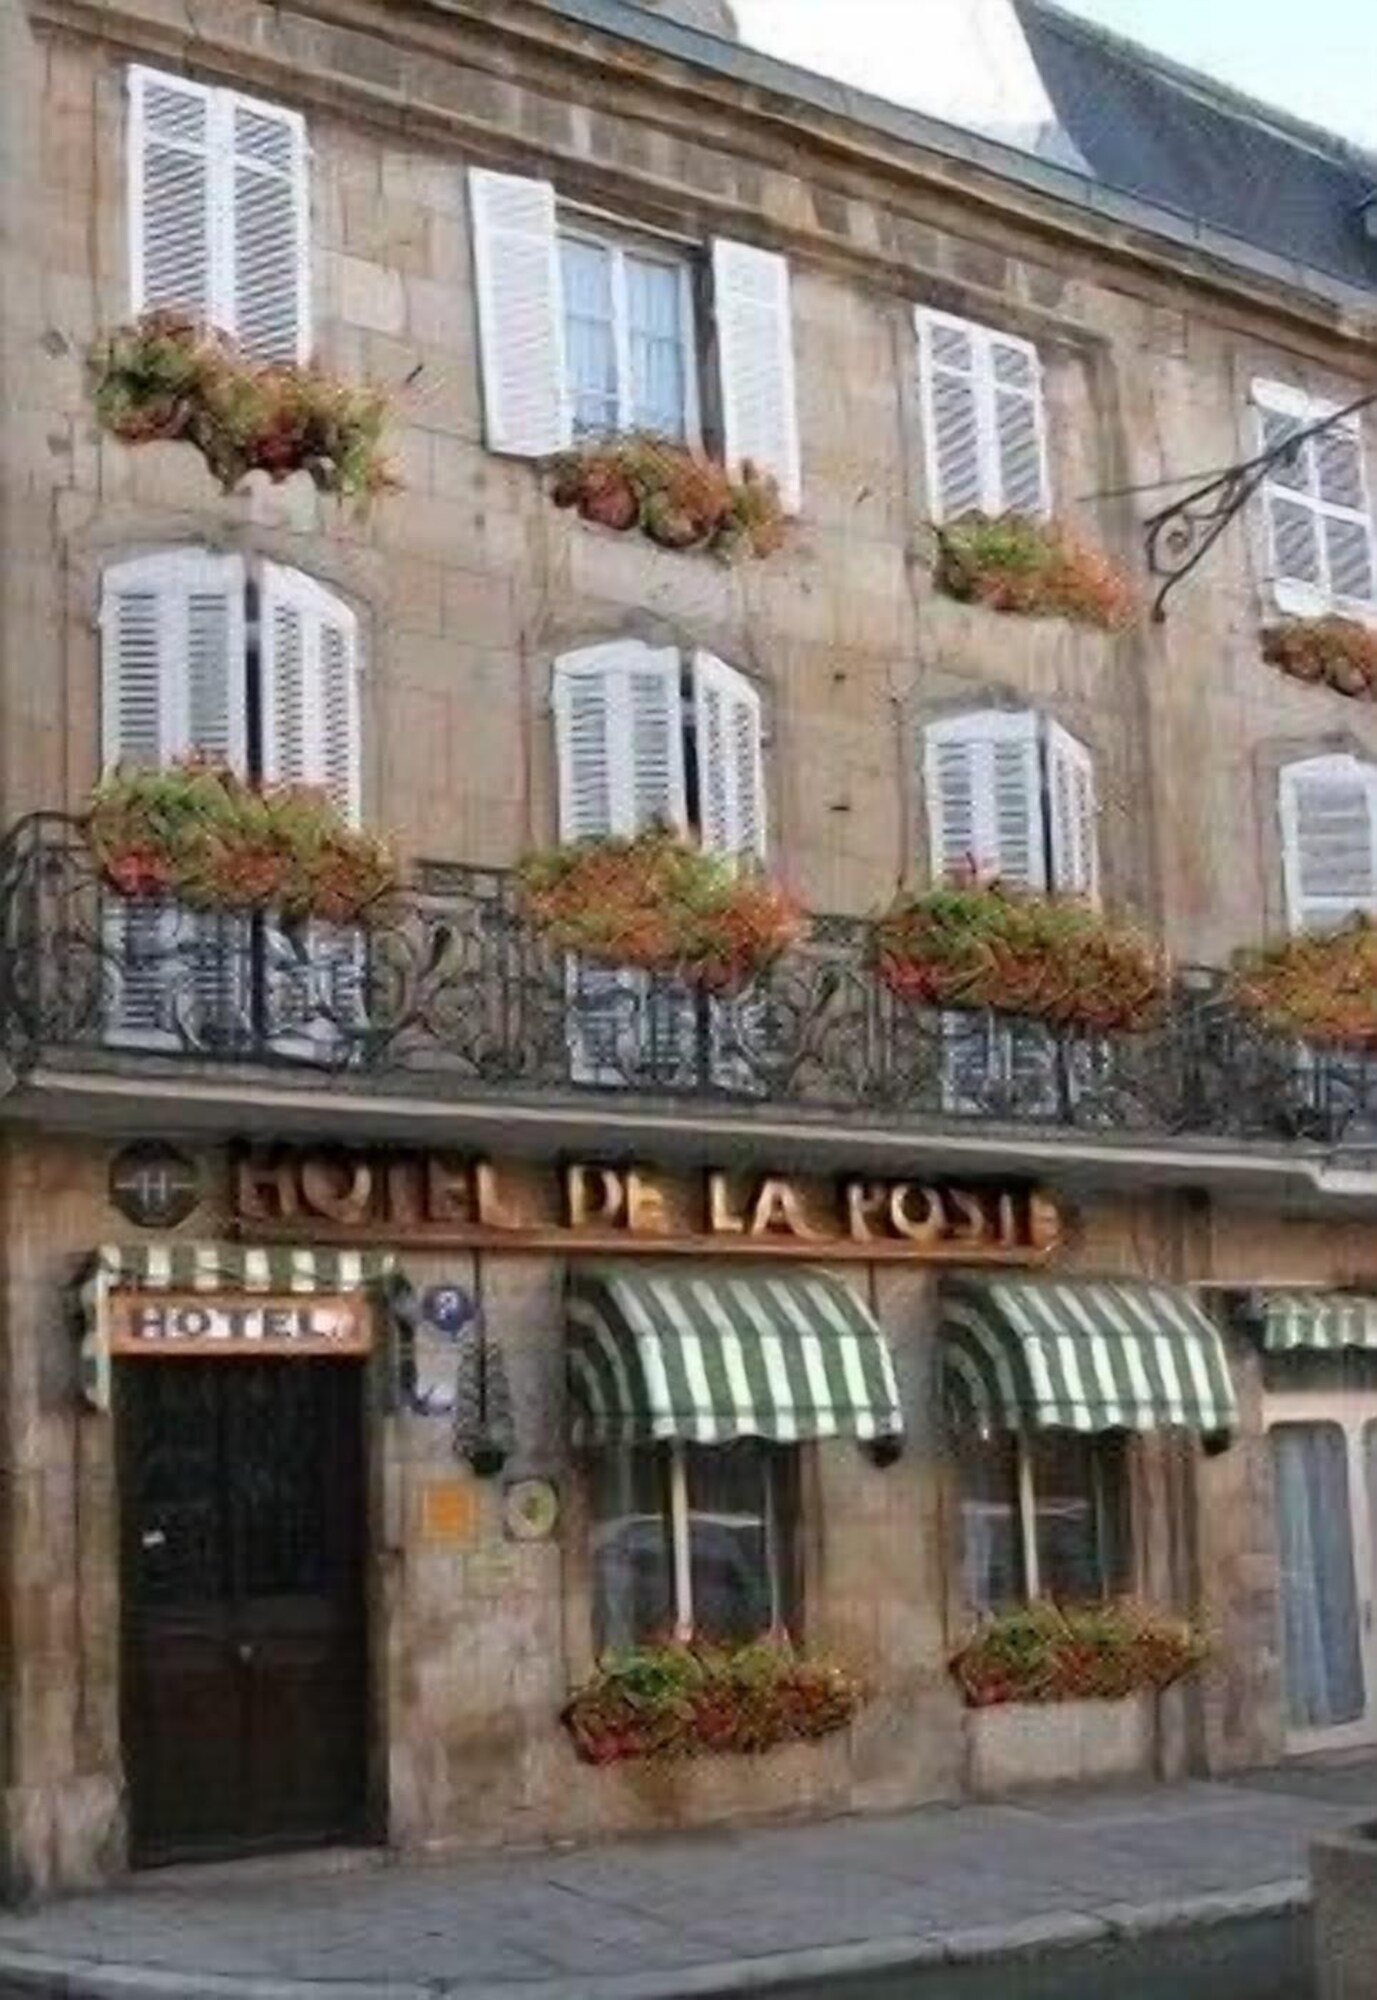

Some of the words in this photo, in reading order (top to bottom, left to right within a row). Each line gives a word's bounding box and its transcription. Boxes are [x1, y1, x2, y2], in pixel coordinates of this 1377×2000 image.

[238, 1158, 526, 1230] HOTEL
[568, 1164, 672, 1236] DE
[710, 1174, 828, 1242] LA
[848, 1180, 1062, 1252] POSTE
[131, 1308, 340, 1341] HOTEL
